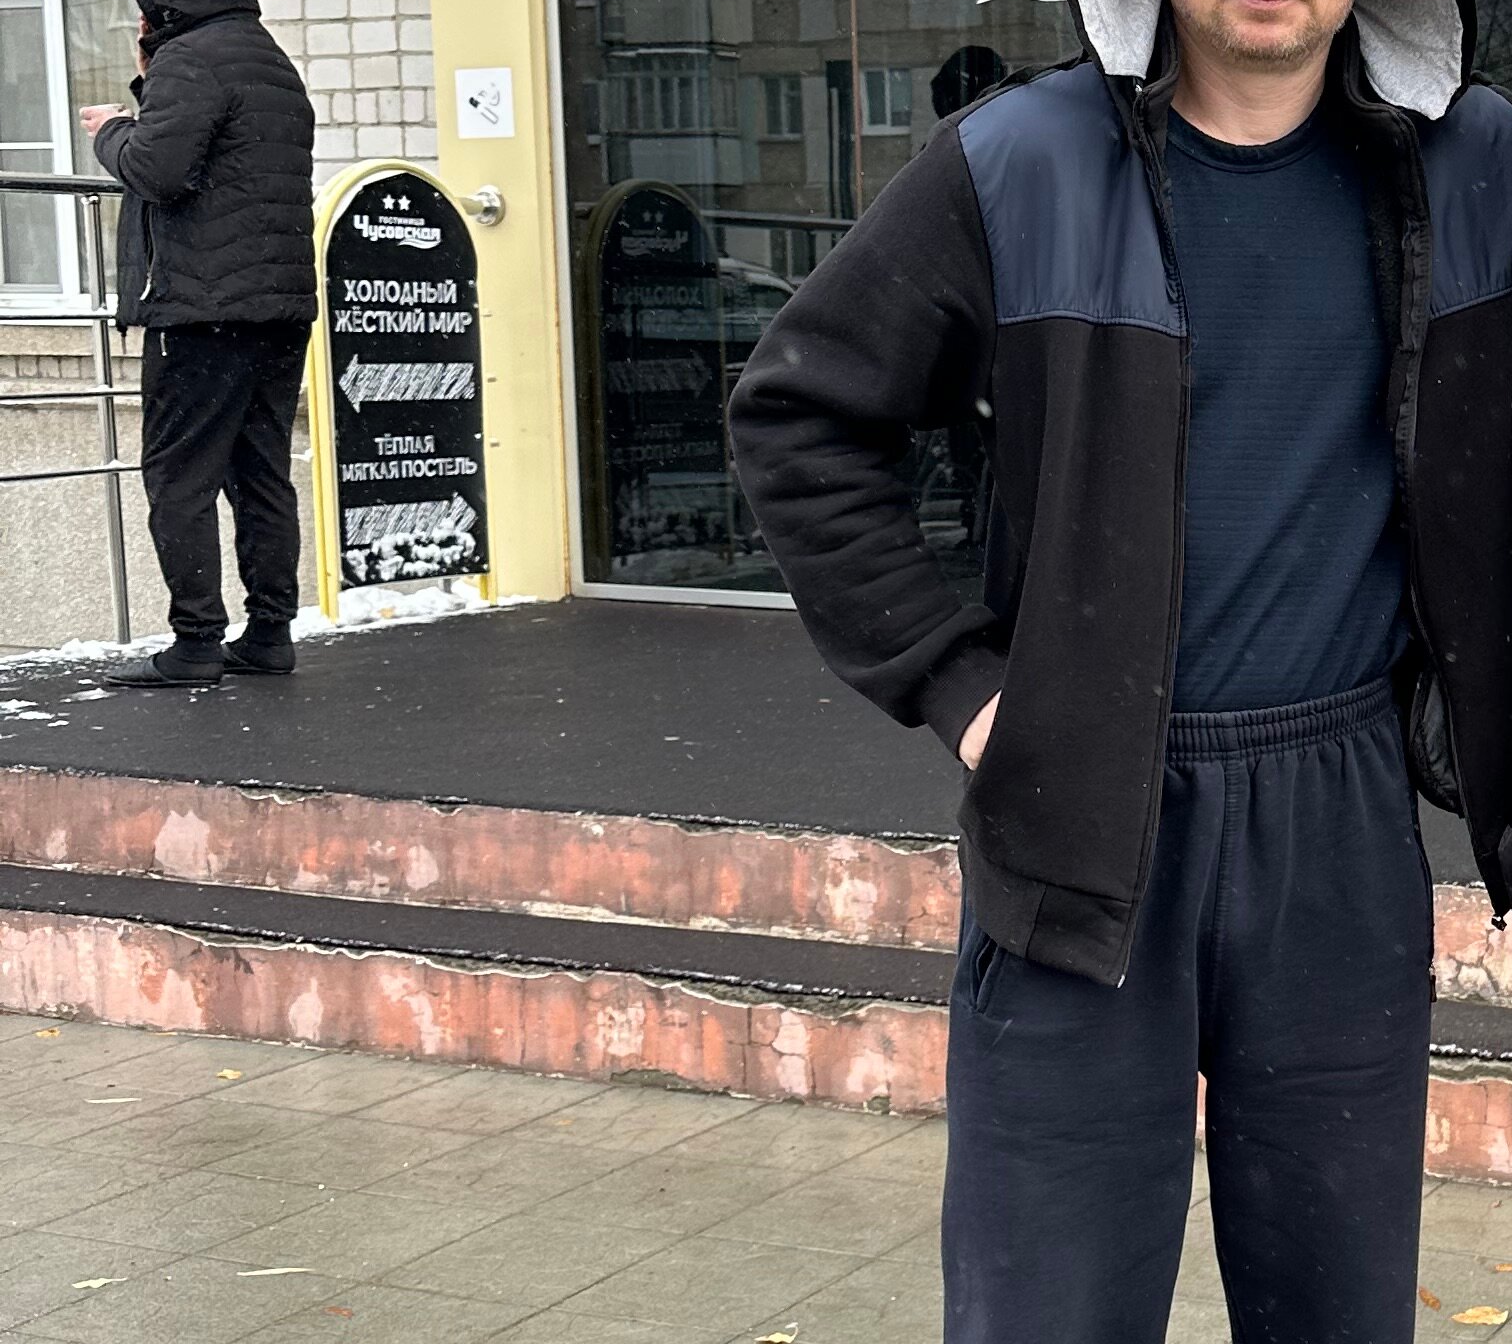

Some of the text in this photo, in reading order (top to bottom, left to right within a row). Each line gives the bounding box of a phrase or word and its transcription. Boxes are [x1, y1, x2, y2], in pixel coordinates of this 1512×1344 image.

[353, 214, 442, 242] Чусовская
[343, 278, 457, 306] ХОЛОДНЫЙ
[334, 305, 473, 334] ЖЁСТКИЙ МИР
[374, 433, 435, 456] ТЁПЛАЯ
[341, 456, 478, 483] МЯГКАЯ ПОСТЕЛЬ
